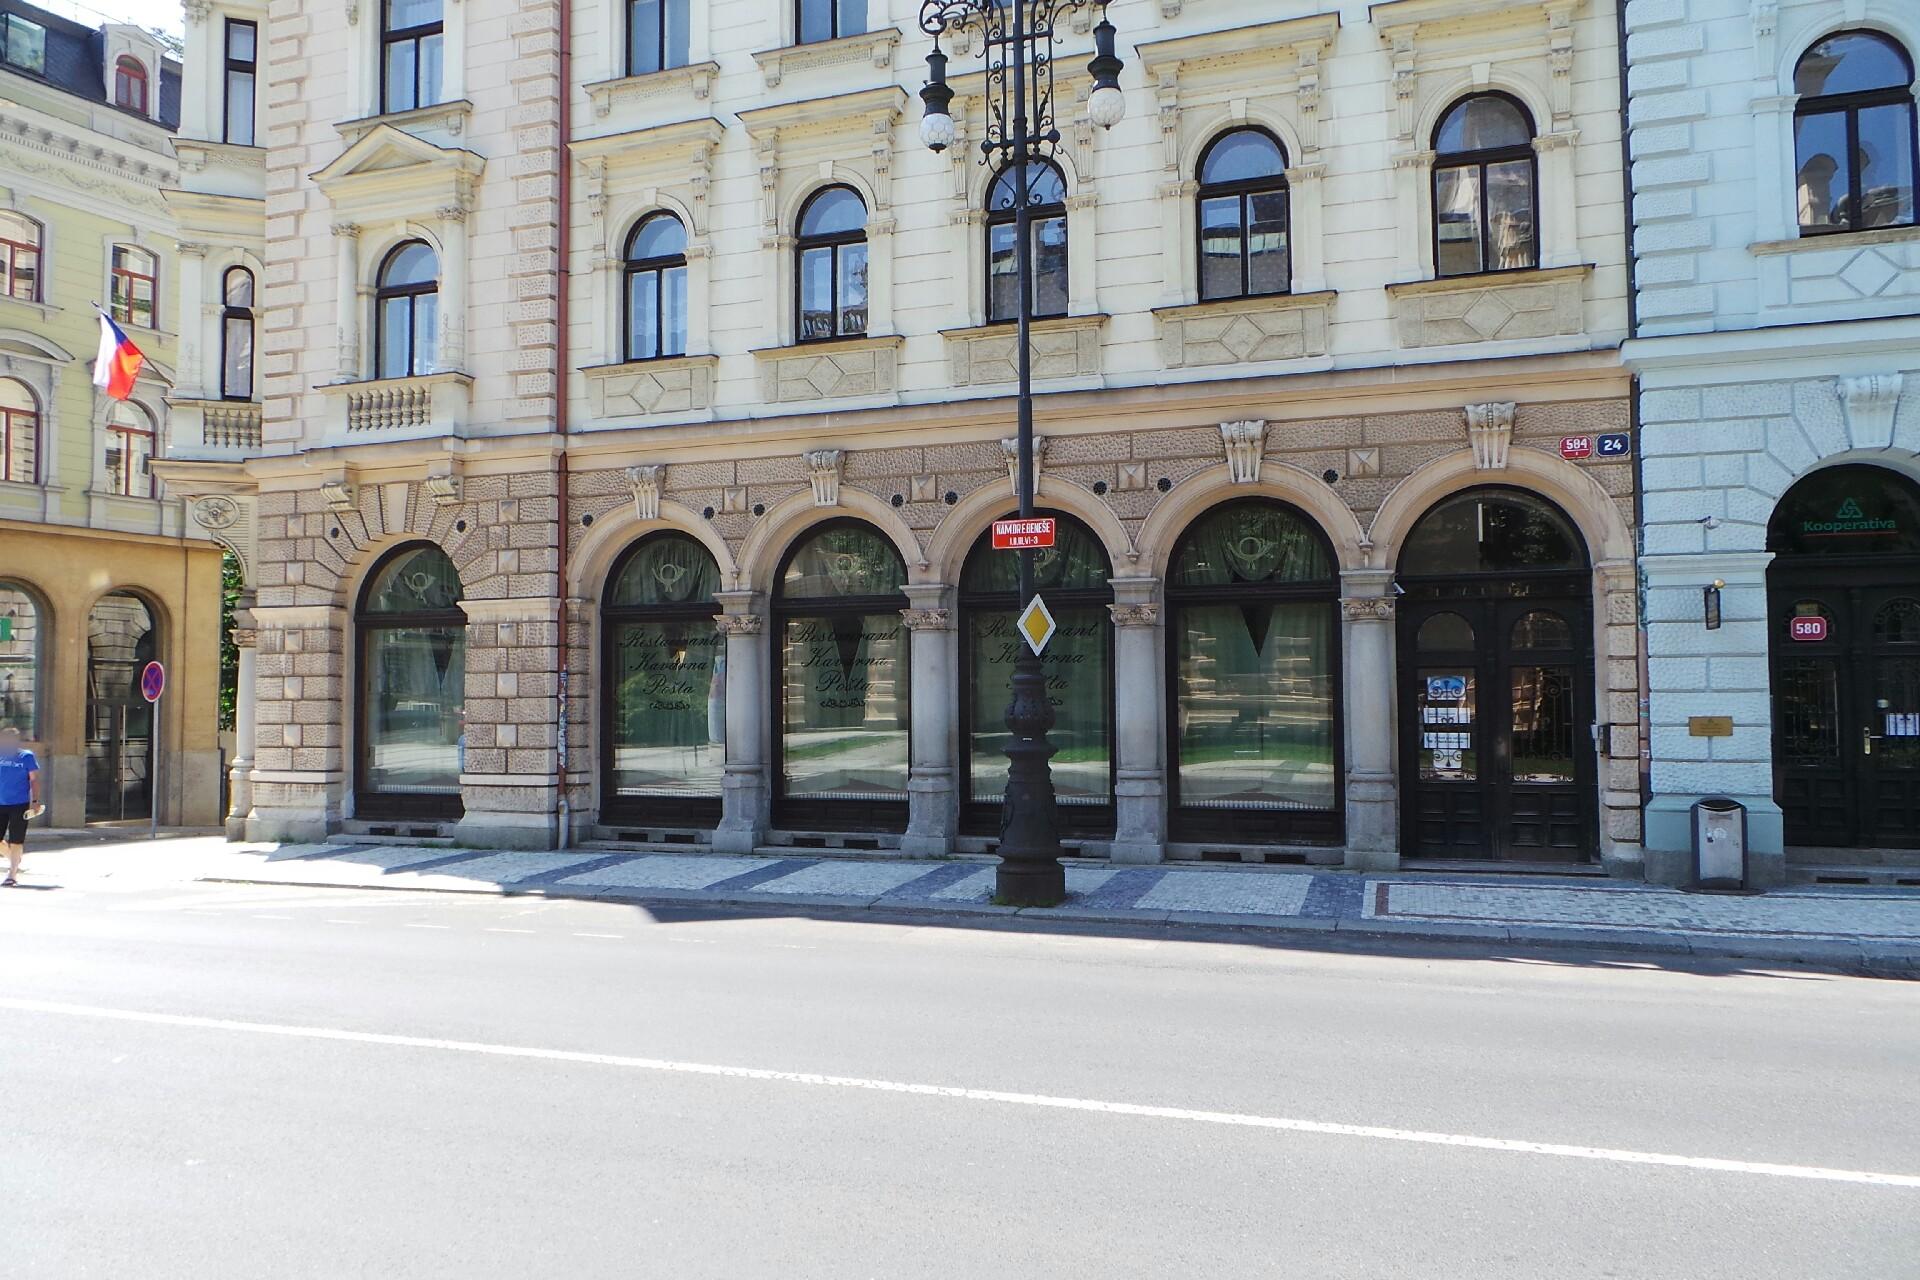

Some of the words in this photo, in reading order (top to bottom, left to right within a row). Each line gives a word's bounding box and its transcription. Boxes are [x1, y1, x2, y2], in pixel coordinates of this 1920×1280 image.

[1566, 438, 1588, 450] 584
[1603, 439, 1623, 451] 24
[1804, 517, 1896, 533] Kooperativa
[789, 624, 899, 643] Restrant
[976, 616, 1098, 638] Resrant
[1796, 622, 1821, 634] 580
[618, 630, 720, 648] Restaant
[642, 674, 695, 695] Pošta
